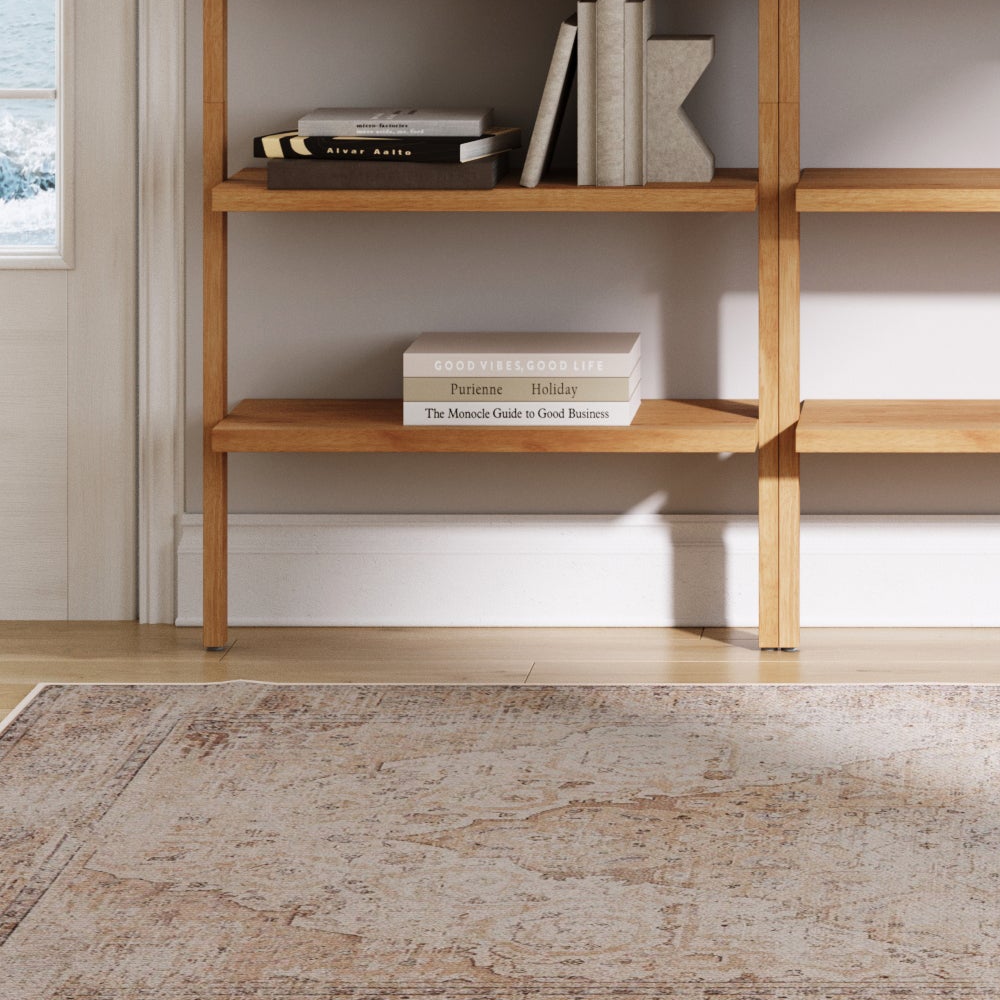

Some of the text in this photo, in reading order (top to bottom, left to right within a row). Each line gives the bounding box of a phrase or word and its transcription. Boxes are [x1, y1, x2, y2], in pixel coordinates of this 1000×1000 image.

[326, 147, 412, 156] Alvar Aalto
[434, 360, 475, 371] GOOD
[573, 360, 604, 371] LIFE
[450, 382, 578, 398] Purienne Holiday
[425, 408, 610, 419] The Monocle Guide to Good Business
